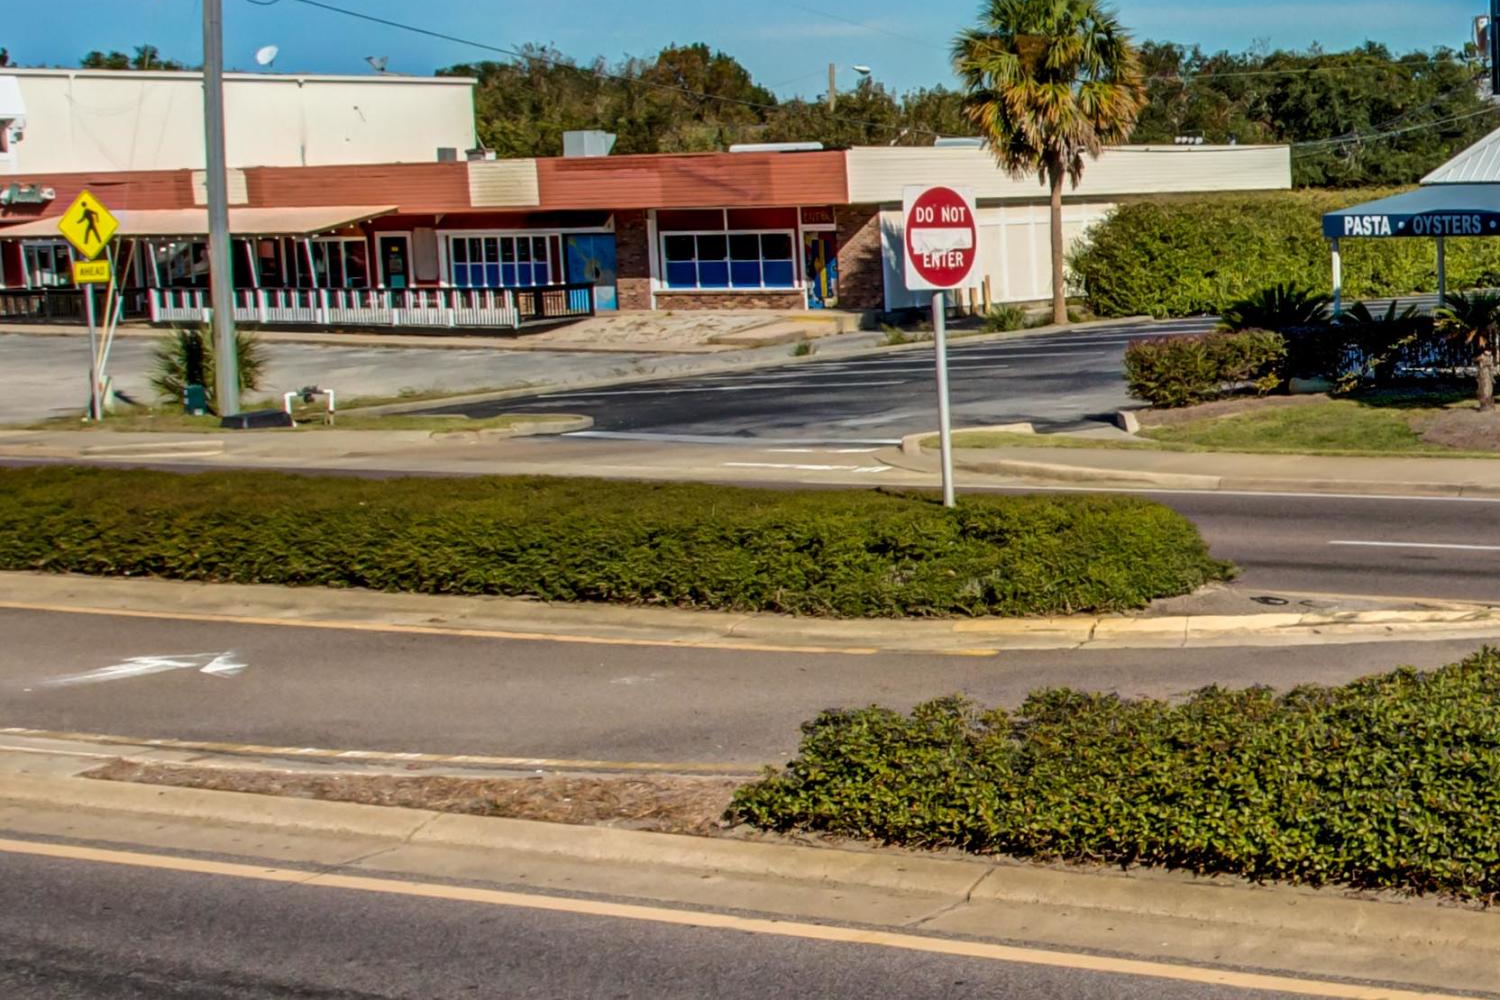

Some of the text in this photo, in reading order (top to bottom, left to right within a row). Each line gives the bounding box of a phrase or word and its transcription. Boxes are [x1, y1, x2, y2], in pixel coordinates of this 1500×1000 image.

[915, 206, 966, 223] DO NOT
[1344, 214, 1392, 236] PASTA
[1413, 214, 1482, 235] OYSTERS
[923, 251, 964, 268] ENTER
[79, 267, 105, 276] AHEAD
